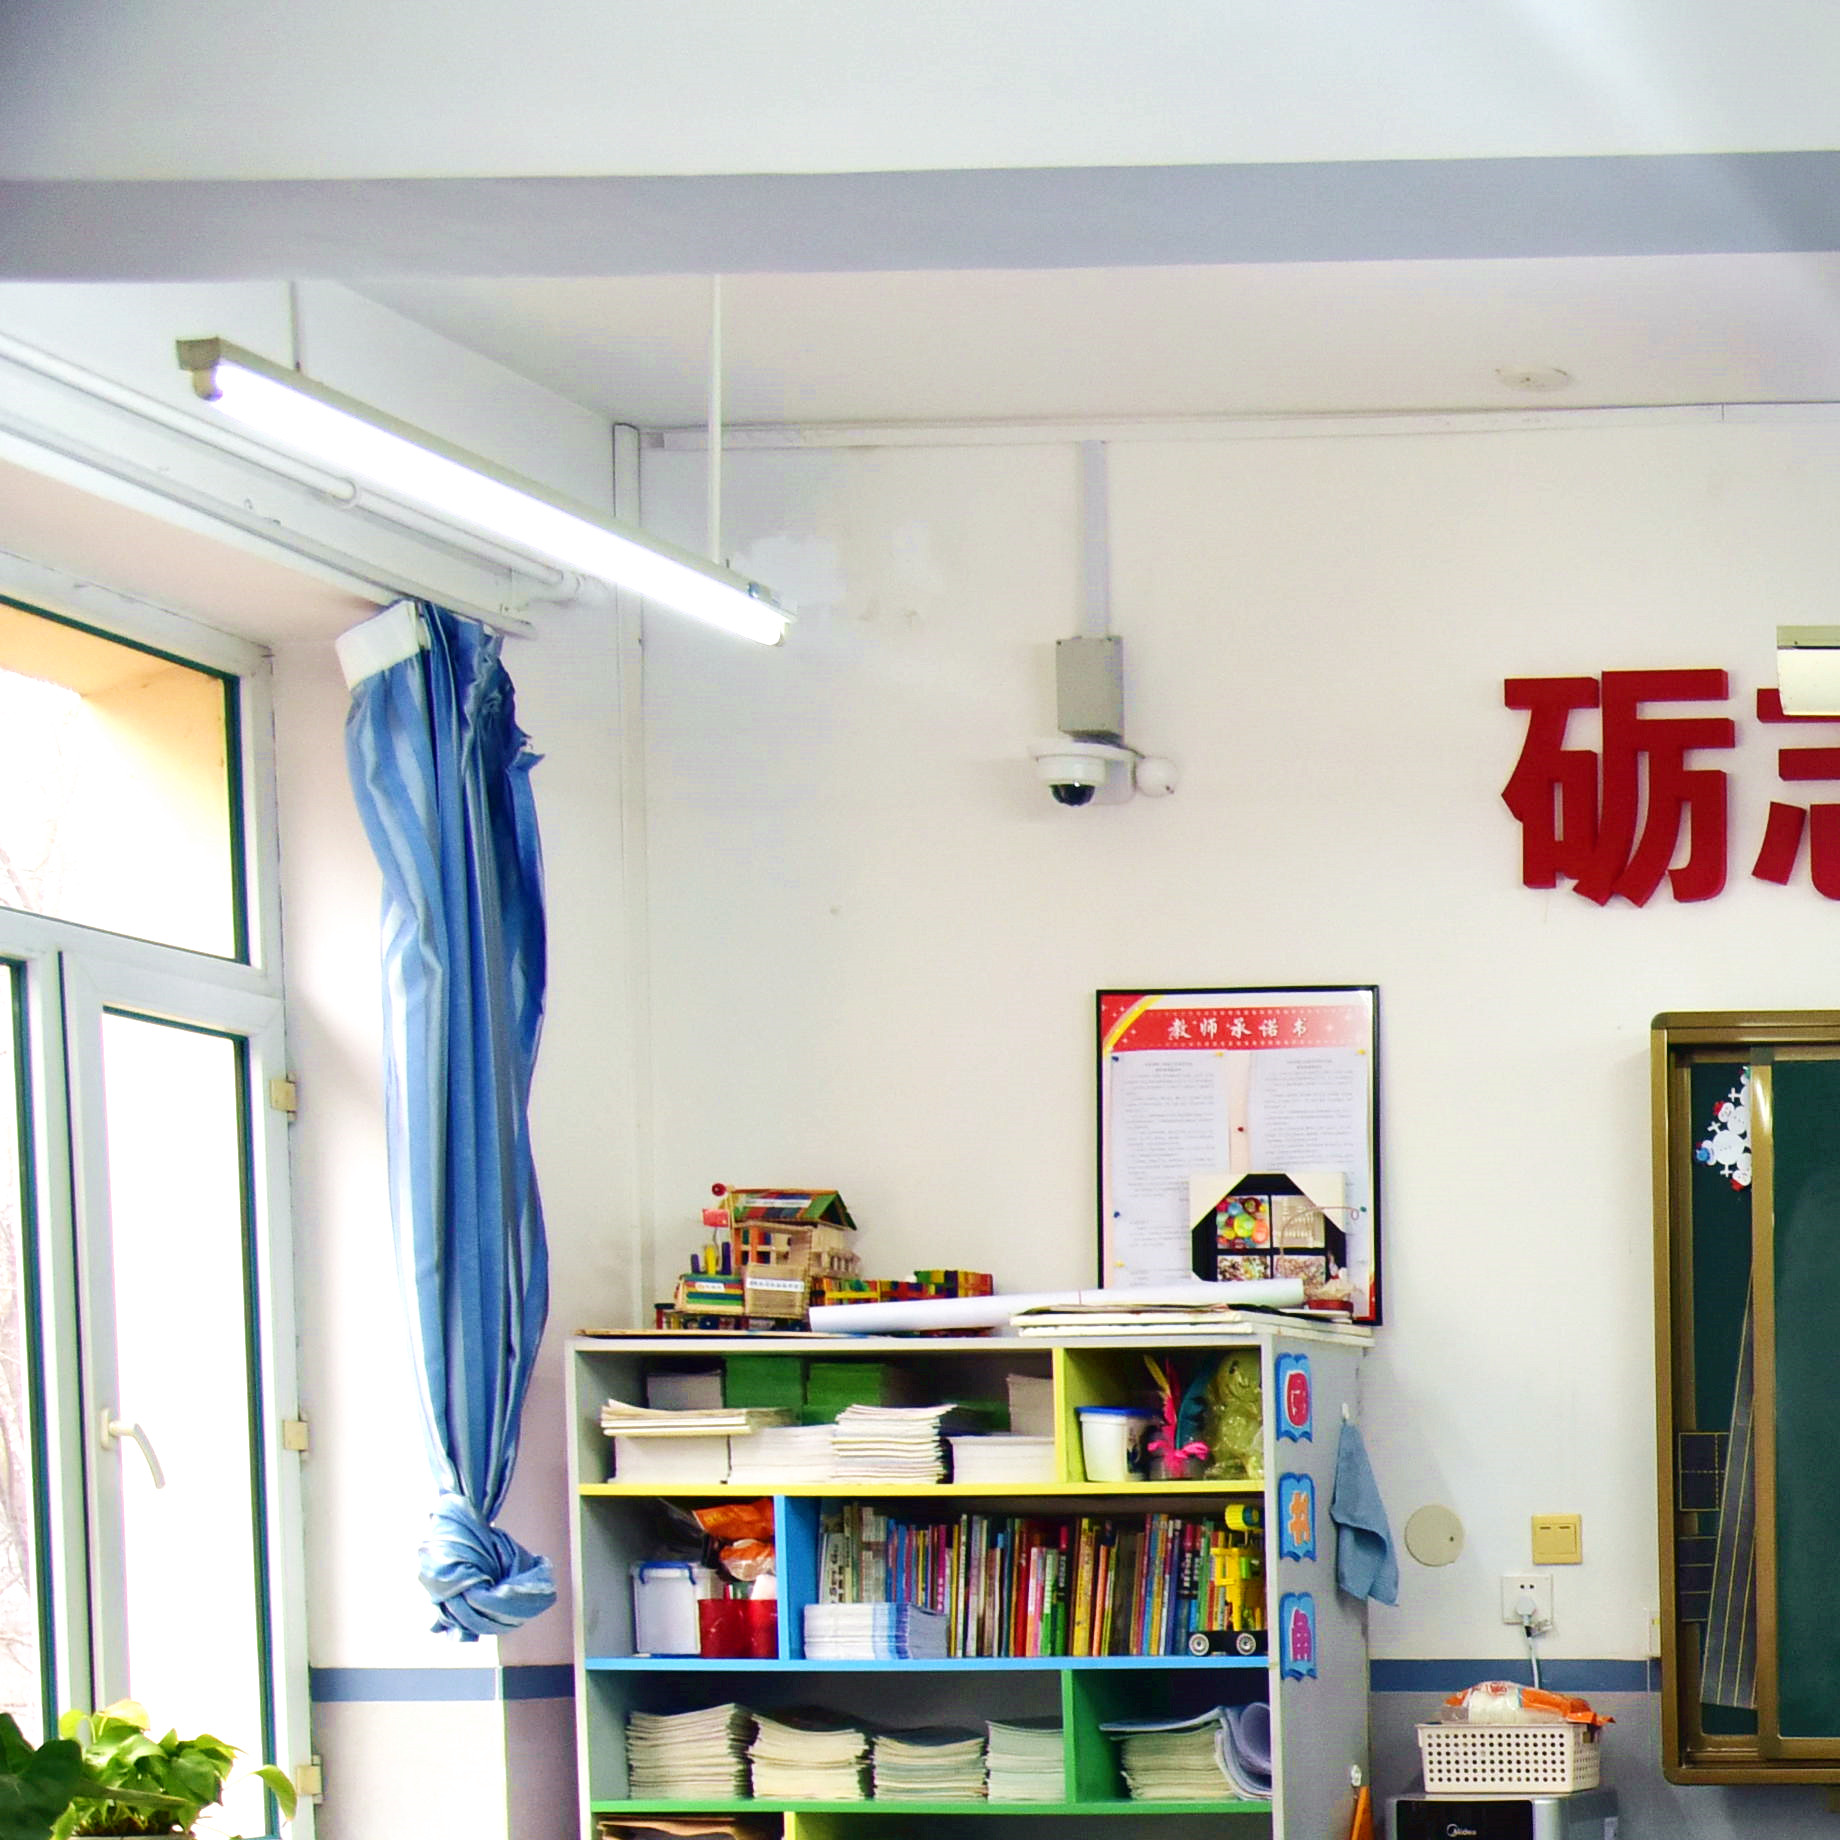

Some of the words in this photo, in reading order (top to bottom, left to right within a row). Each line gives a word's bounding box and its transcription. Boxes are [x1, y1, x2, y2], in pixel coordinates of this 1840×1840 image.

[1167, 1016, 1309, 1041] 教师承诺书
